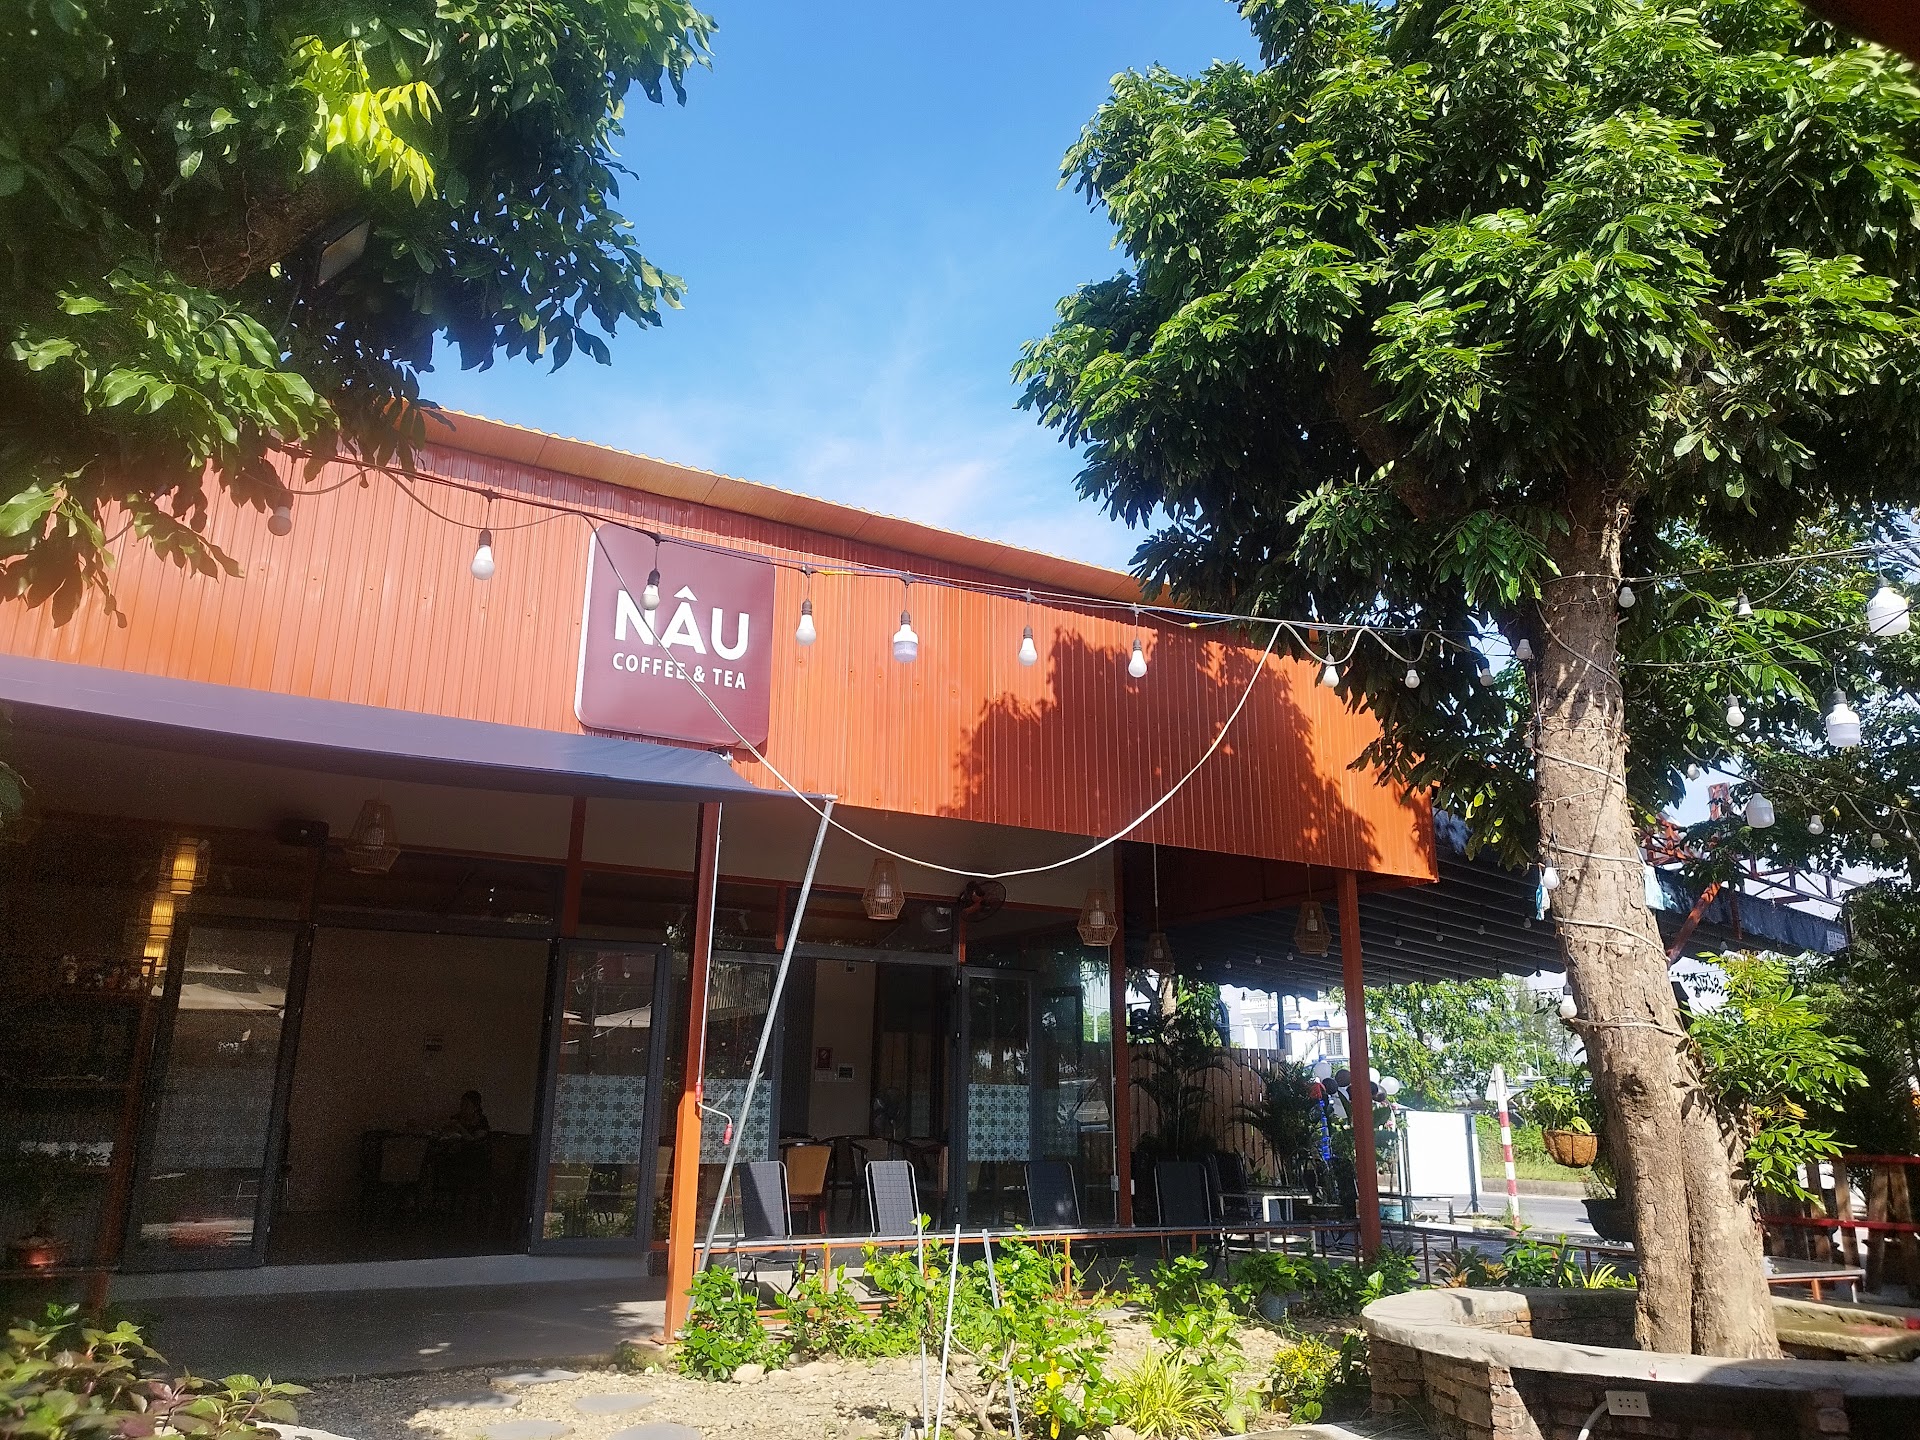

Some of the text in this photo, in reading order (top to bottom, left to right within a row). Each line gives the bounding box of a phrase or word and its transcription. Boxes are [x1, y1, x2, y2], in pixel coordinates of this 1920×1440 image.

[614, 585, 750, 661] NÂU
[612, 652, 746, 690] COFFEE & TEA
